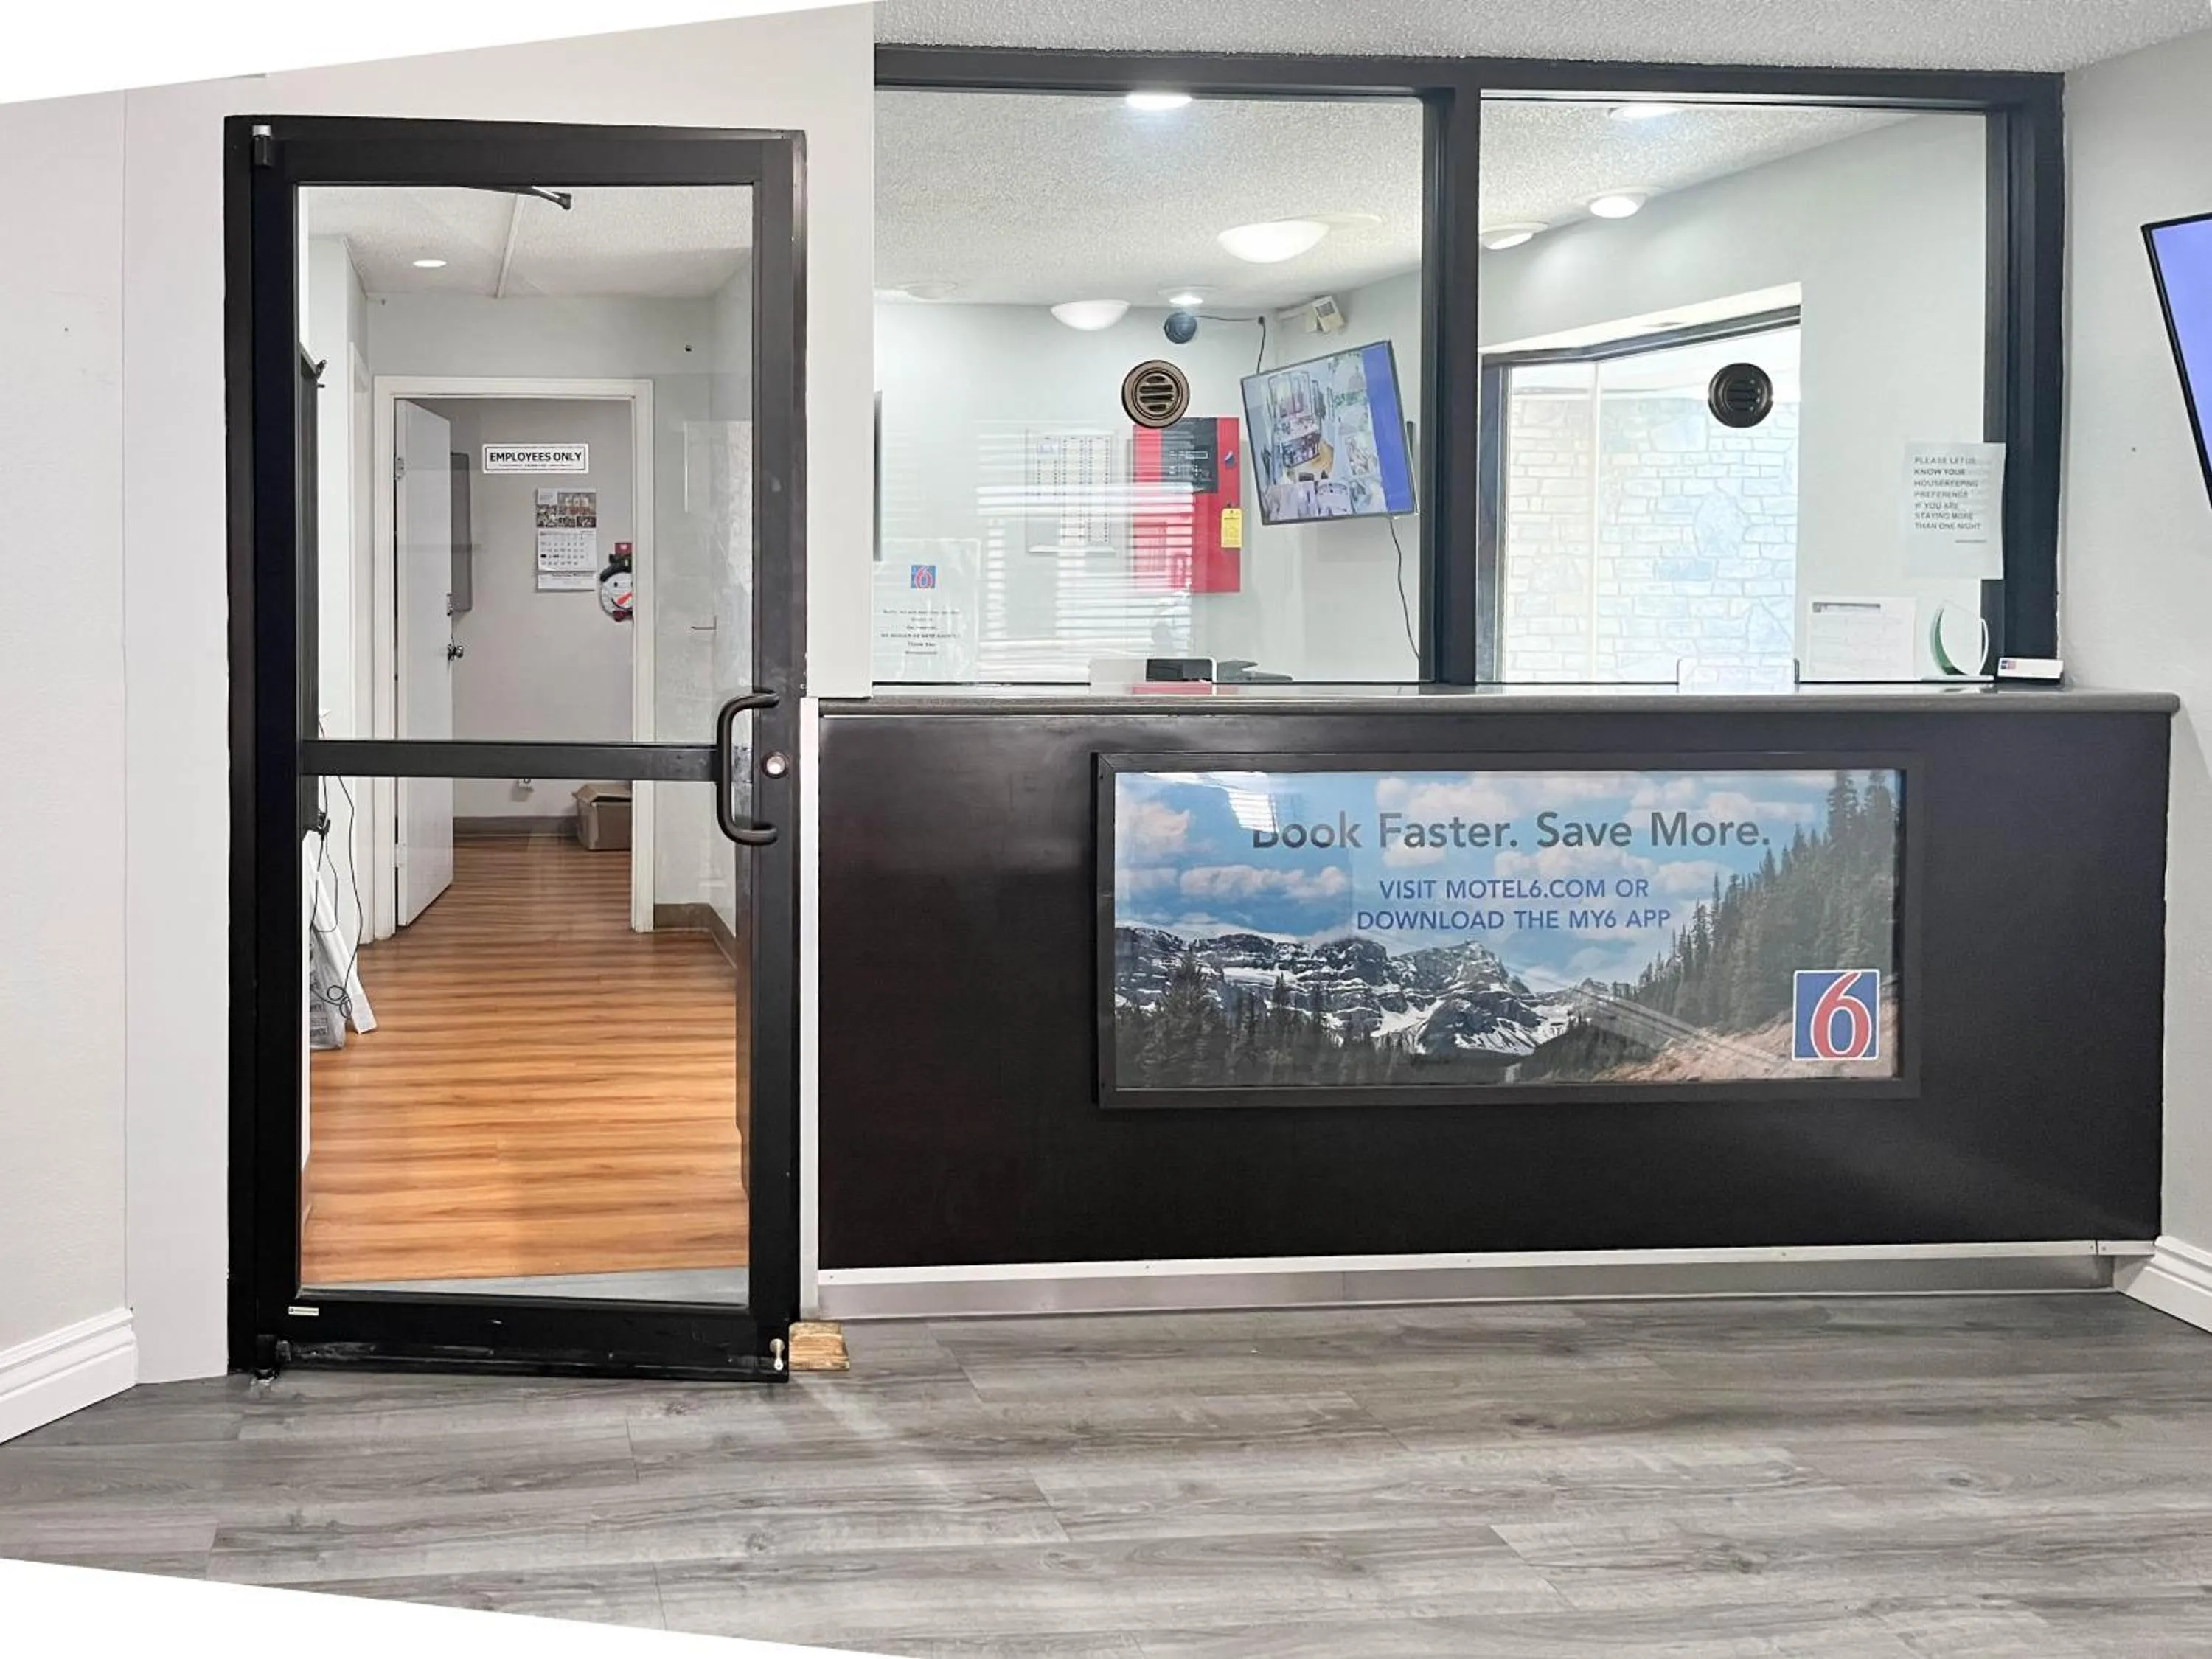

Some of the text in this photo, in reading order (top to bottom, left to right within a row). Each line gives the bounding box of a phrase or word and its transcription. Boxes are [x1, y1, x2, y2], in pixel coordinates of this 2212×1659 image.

[490, 452, 582, 462] EMPLOYEES ONLY
[1914, 490, 1968, 498] PREFERENCE
[1380, 811, 1518, 849] Faster.
[1536, 810, 1632, 848] Save
[1651, 811, 1770, 847] More.
[1380, 878, 1649, 899] VISIT MOTEL6.COM OR
[1357, 908, 1671, 930] DOWNLOAD THE MY6 APP
[1810, 970, 1873, 1060] 6
